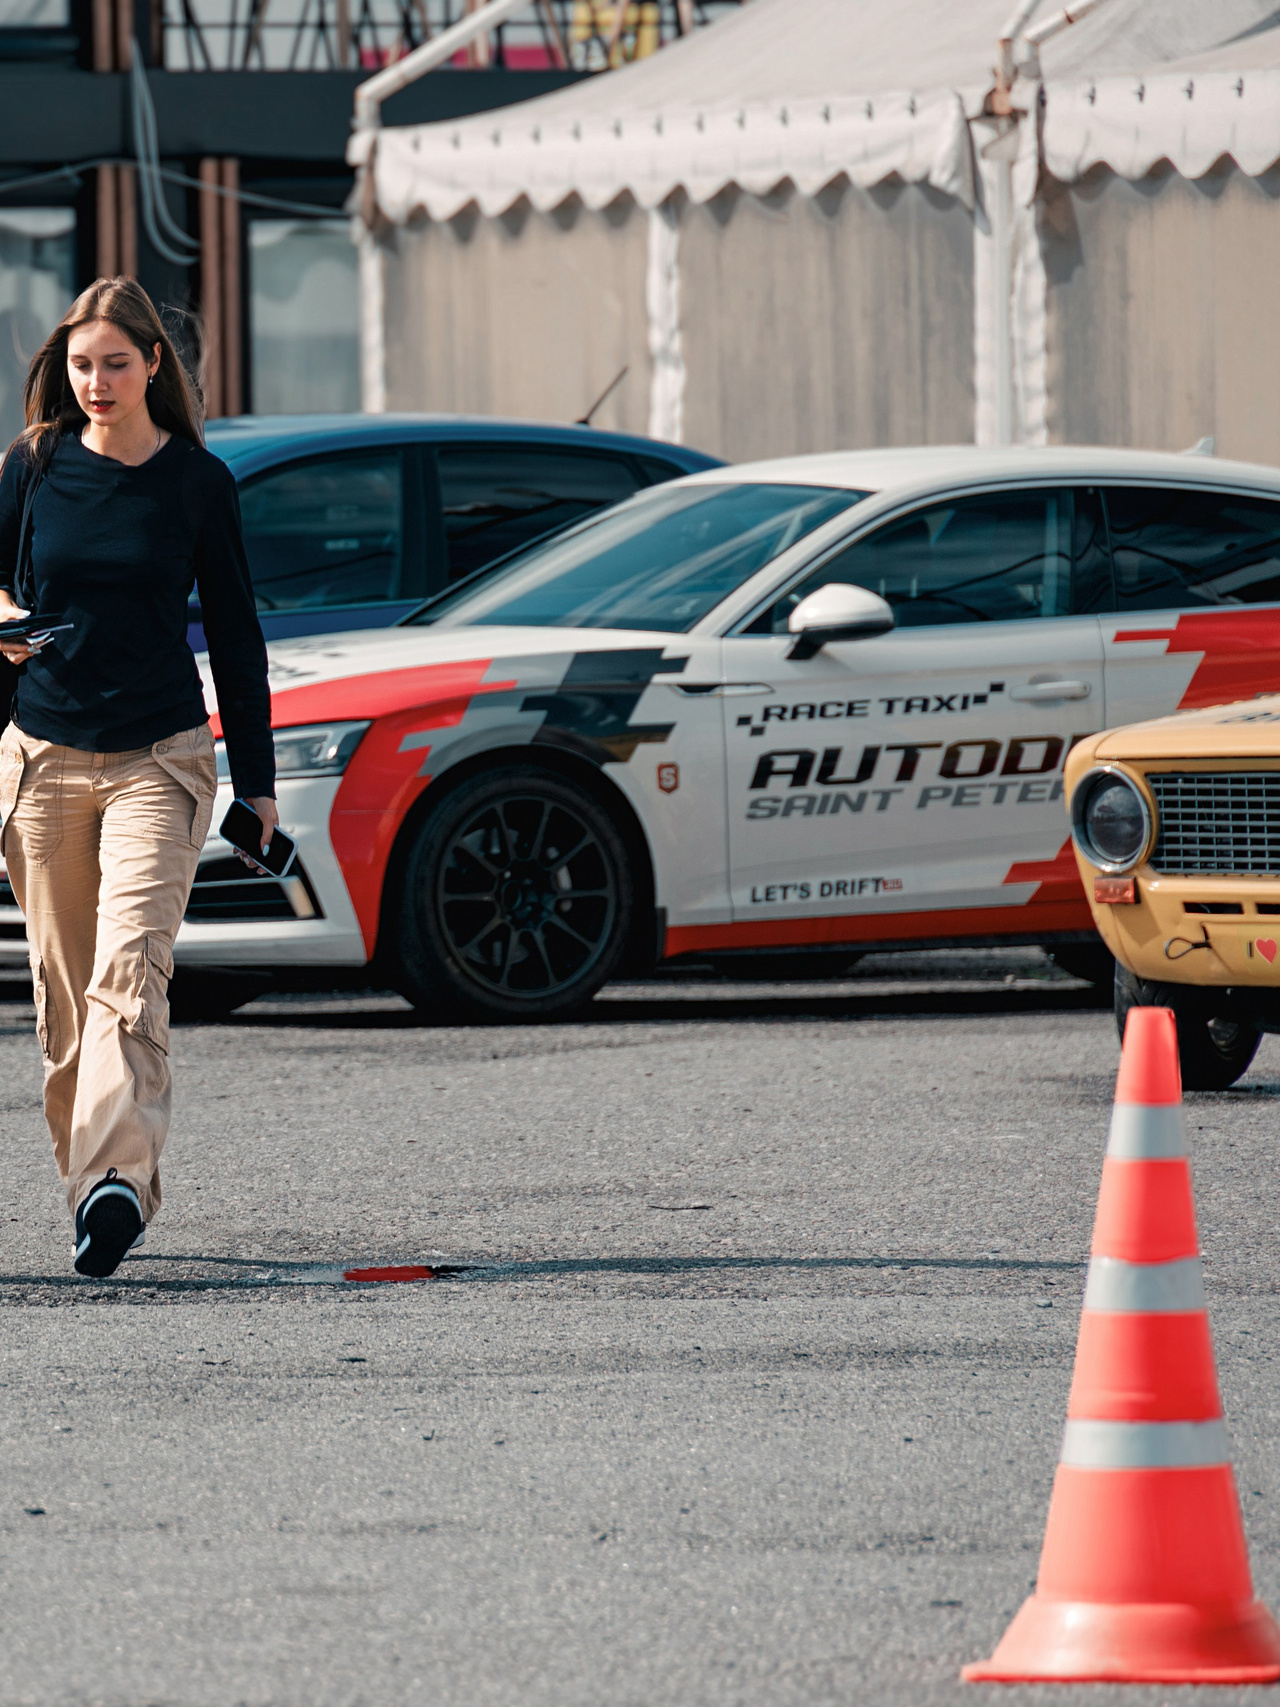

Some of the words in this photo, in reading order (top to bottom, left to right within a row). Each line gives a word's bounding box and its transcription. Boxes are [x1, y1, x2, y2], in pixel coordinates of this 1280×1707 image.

[761, 700, 869, 722] RACE
[879, 695, 970, 716] TAXI
[745, 787, 905, 820] SAINT
[751, 880, 811, 903] LET'S
[820, 877, 884, 898] DRIFT
